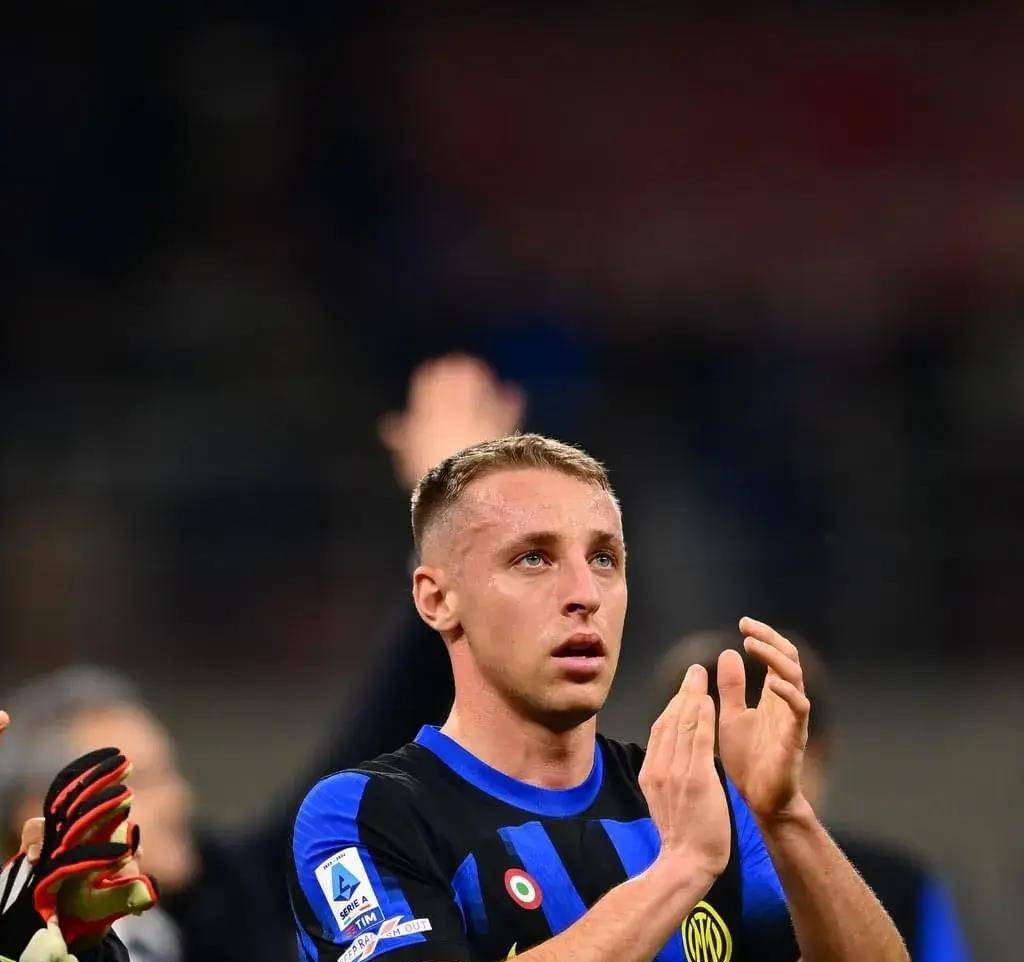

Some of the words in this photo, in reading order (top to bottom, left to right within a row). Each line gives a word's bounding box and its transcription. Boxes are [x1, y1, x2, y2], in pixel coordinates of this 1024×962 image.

[339, 899, 360, 921] SERIE
[361, 895, 369, 903] A
[356, 912, 378, 930] TIM
[404, 919, 428, 933] OUT
